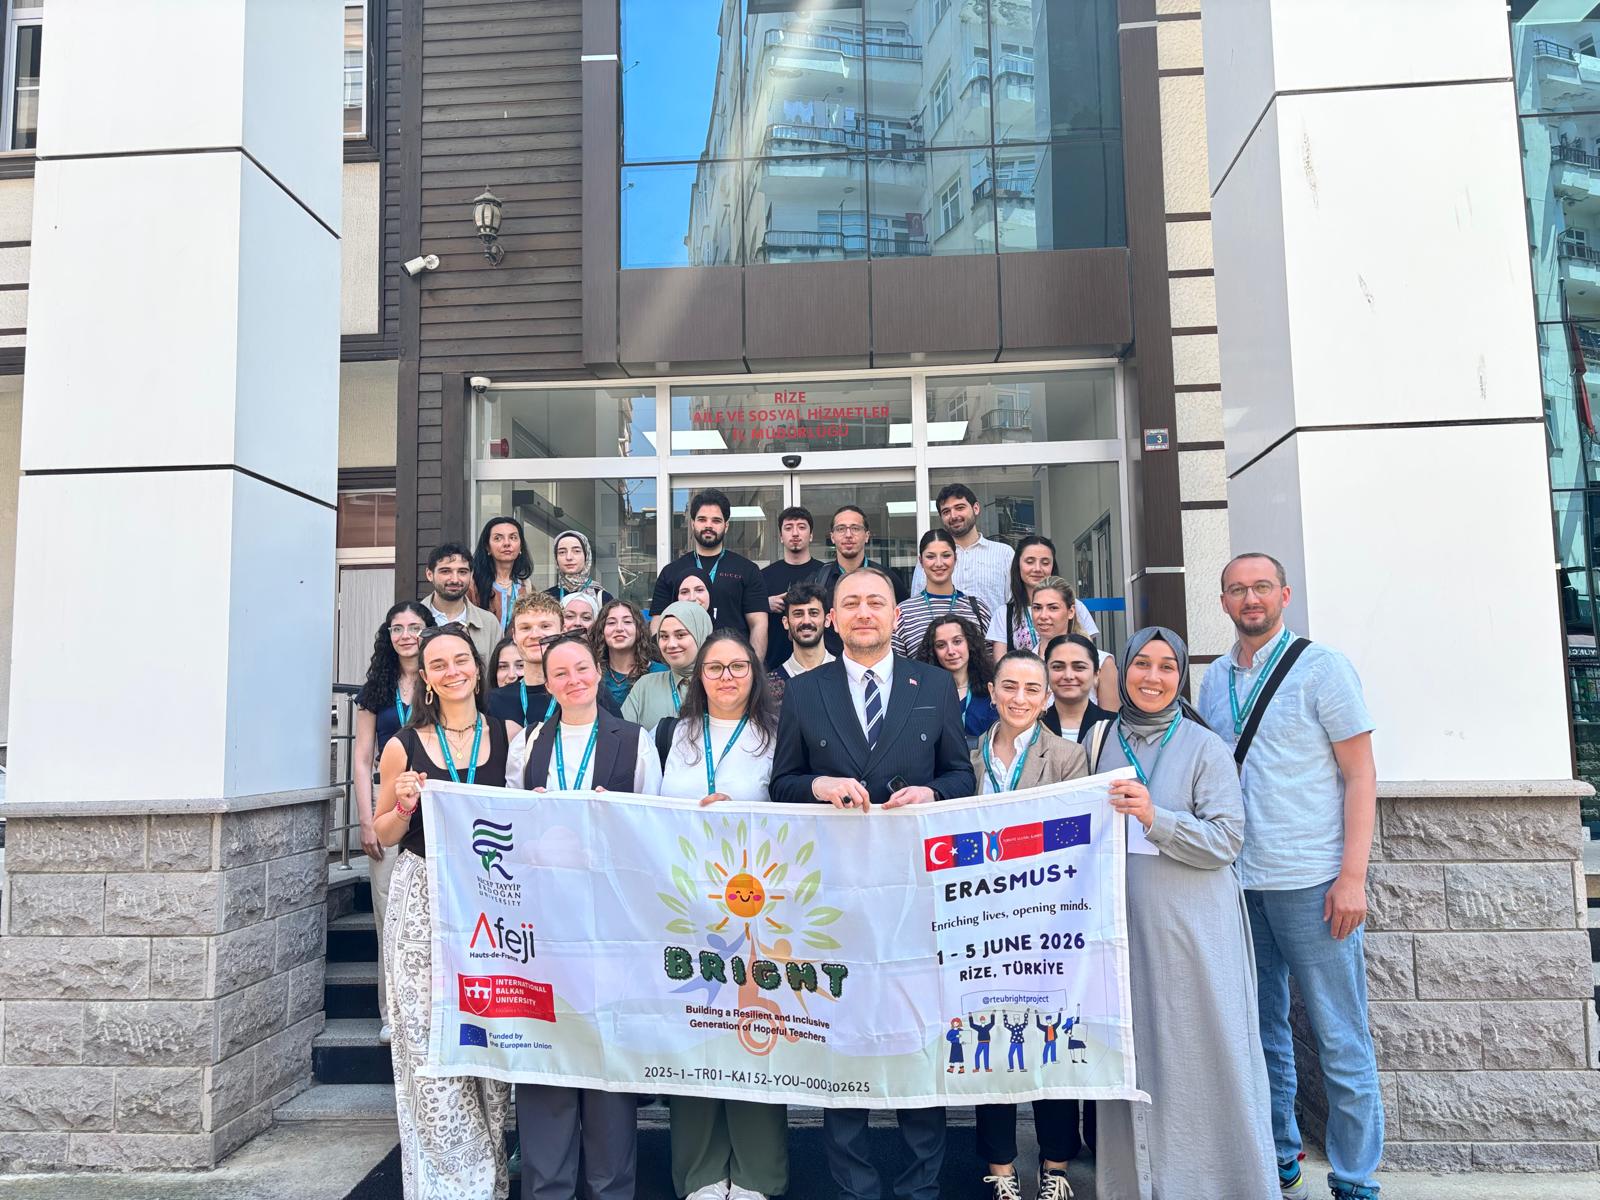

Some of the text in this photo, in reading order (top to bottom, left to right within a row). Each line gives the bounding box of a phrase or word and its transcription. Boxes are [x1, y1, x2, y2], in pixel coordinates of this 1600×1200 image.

[774, 389, 806, 403] RİZE
[726, 407, 745, 423] VE
[748, 407, 801, 421] SOSYAL
[807, 405, 890, 420] HİZMETLER
[751, 423, 849, 440] MÜDÜRLÜĞÜ
[1157, 435, 1163, 443] 3
[944, 864, 1078, 902] ERASMUS+
[931, 898, 1092, 932] Enriching lives, opening minds.
[469, 912, 535, 964] Afeji
[469, 951, 519, 962] Hauts-de-France
[937, 950, 944, 965] 1
[965, 943, 976, 959] 5
[983, 934, 1032, 958] JUNE
[1039, 932, 1085, 950] 2026
[664, 946, 849, 998] BRIGHT
[959, 958, 1065, 982] RİZE, TÜRKİYE
[495, 978, 547, 993] INTERNATIONAL
[495, 987, 524, 995] BALKAN
[495, 996, 537, 1006] UNIVERSITY
[685, 1004, 724, 1018] Building
[733, 1009, 773, 1021] Resilient
[774, 1012, 791, 1023] and
[792, 1014, 830, 1030] Inclusive
[489, 1032, 523, 1041] Funded by
[689, 1019, 827, 1043] Generation of Hopeful Teachers
[489, 1040, 552, 1050] the European Union
[644, 1066, 871, 1093] 2025-1-TR01-KA152-YOU-000302625
